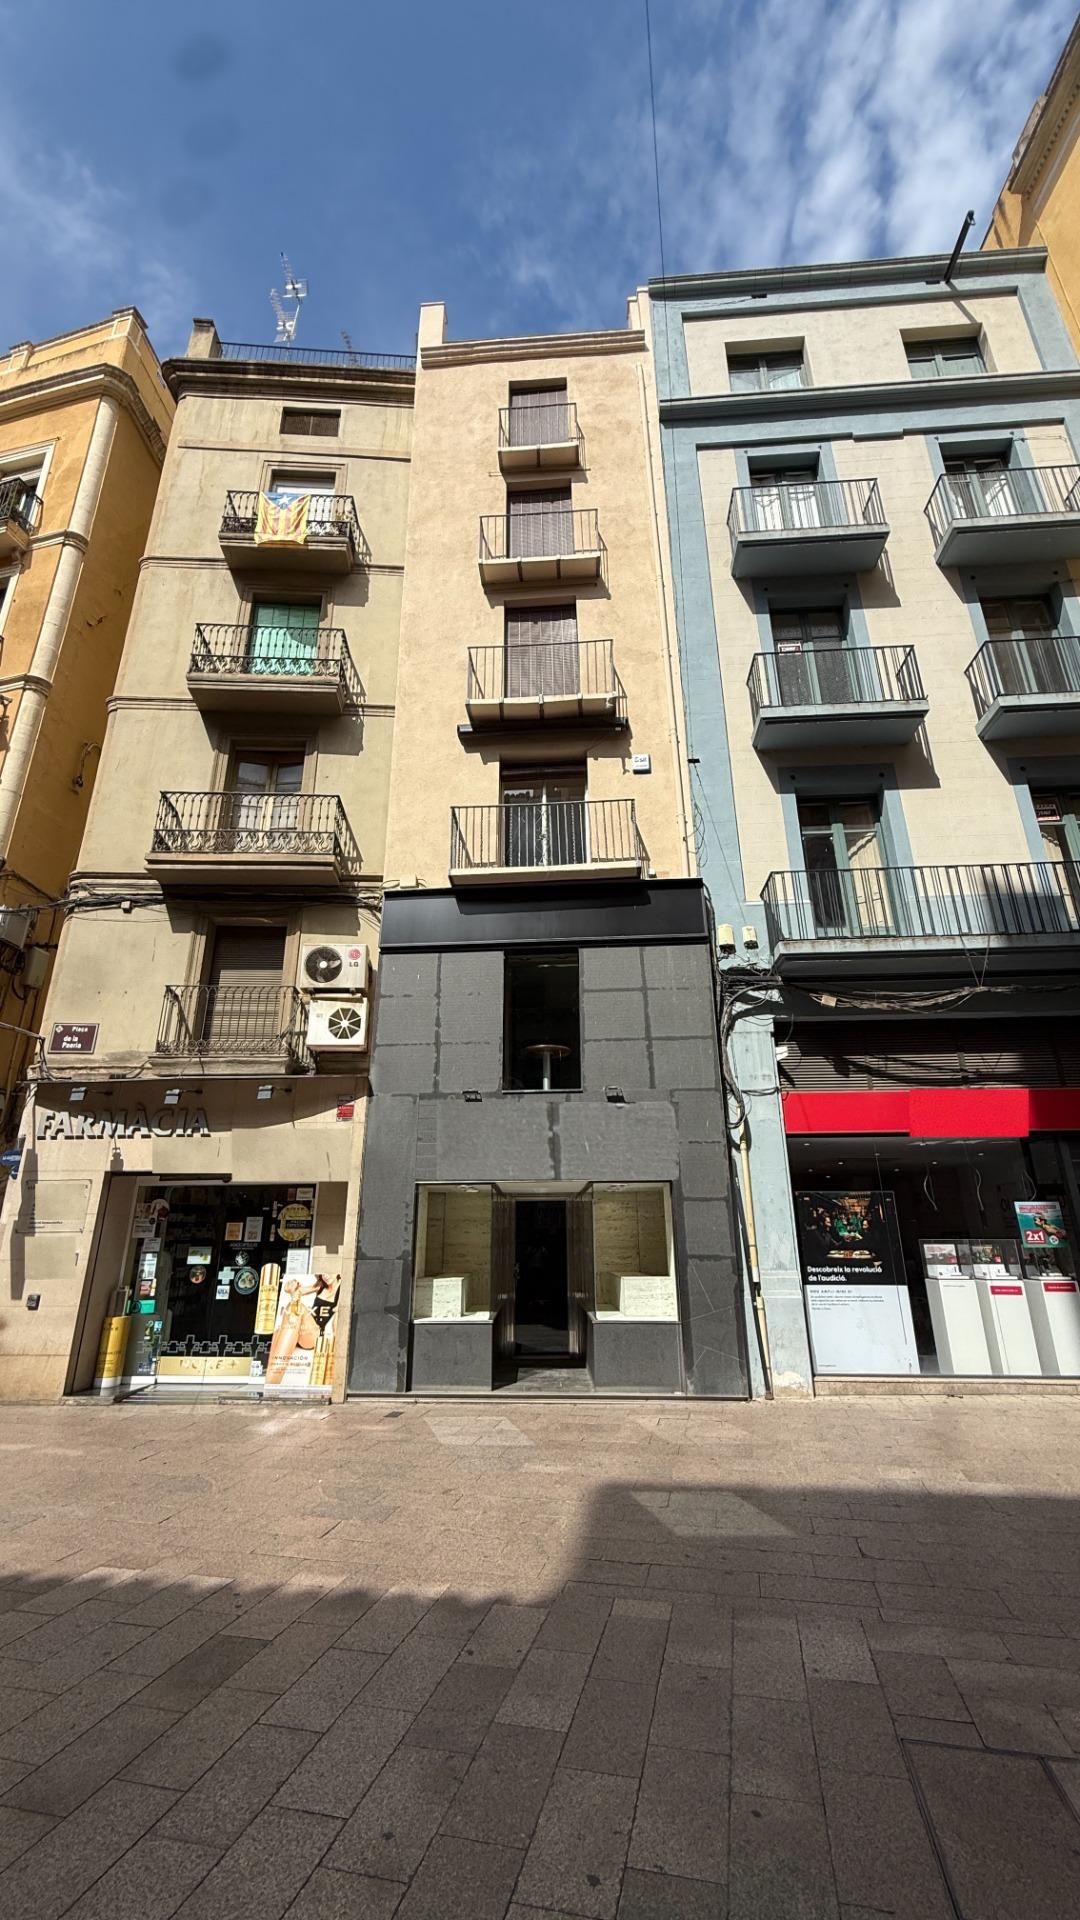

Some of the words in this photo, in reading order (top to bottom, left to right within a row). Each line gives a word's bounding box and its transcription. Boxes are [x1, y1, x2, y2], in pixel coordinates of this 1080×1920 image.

[37, 1103, 211, 1140] FARMÀCIA
[1026, 1230, 1045, 1241] 2x1
[852, 1265, 882, 1273] revolució
[818, 1274, 847, 1282] l'audició.
